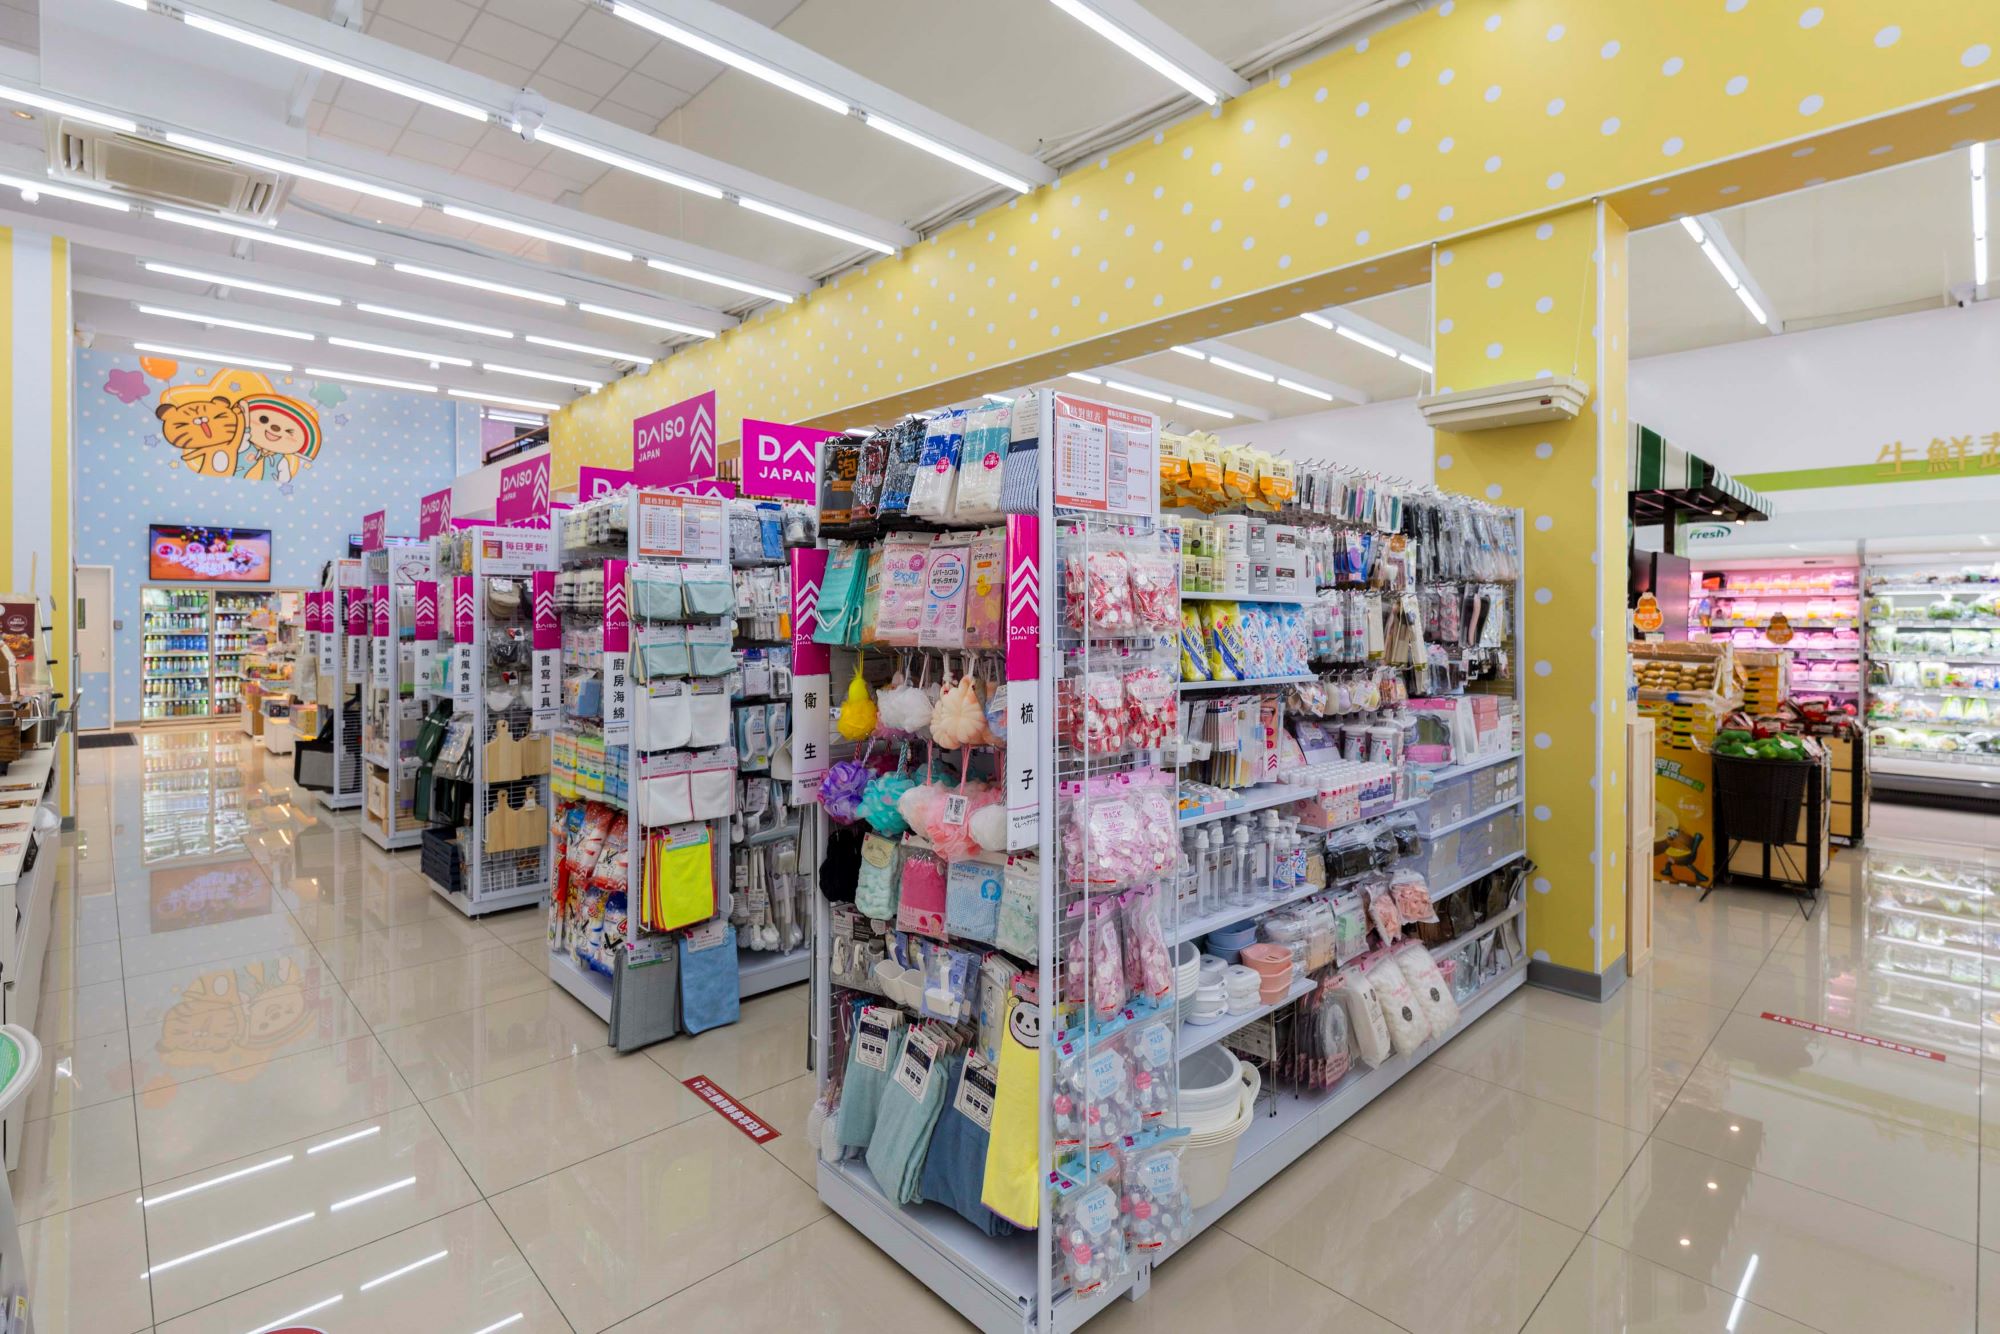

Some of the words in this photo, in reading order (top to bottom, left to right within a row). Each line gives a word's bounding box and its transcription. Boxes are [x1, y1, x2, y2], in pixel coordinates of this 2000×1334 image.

[638, 416, 685, 450] DAISO
[638, 448, 661, 462] JAPAN
[503, 469, 532, 492] DAISO
[759, 466, 815, 484] JAPAN
[421, 499, 440, 517] DAISO
[1010, 625, 1039, 636] DAISO
[460, 648, 471, 694] 和風食器
[540, 655, 551, 708] 書寫工具
[613, 658, 625, 720] 廚房海綿
[804, 692, 817, 760] 衛生
[1020, 702, 1035, 791] 梳子
[1103, 811, 1121, 819] MASK
[952, 863, 980, 875] SHOWER
[980, 869, 995, 877] CAP
[1094, 1063, 1113, 1077] MASK
[1087, 1199, 1106, 1214] MASK
